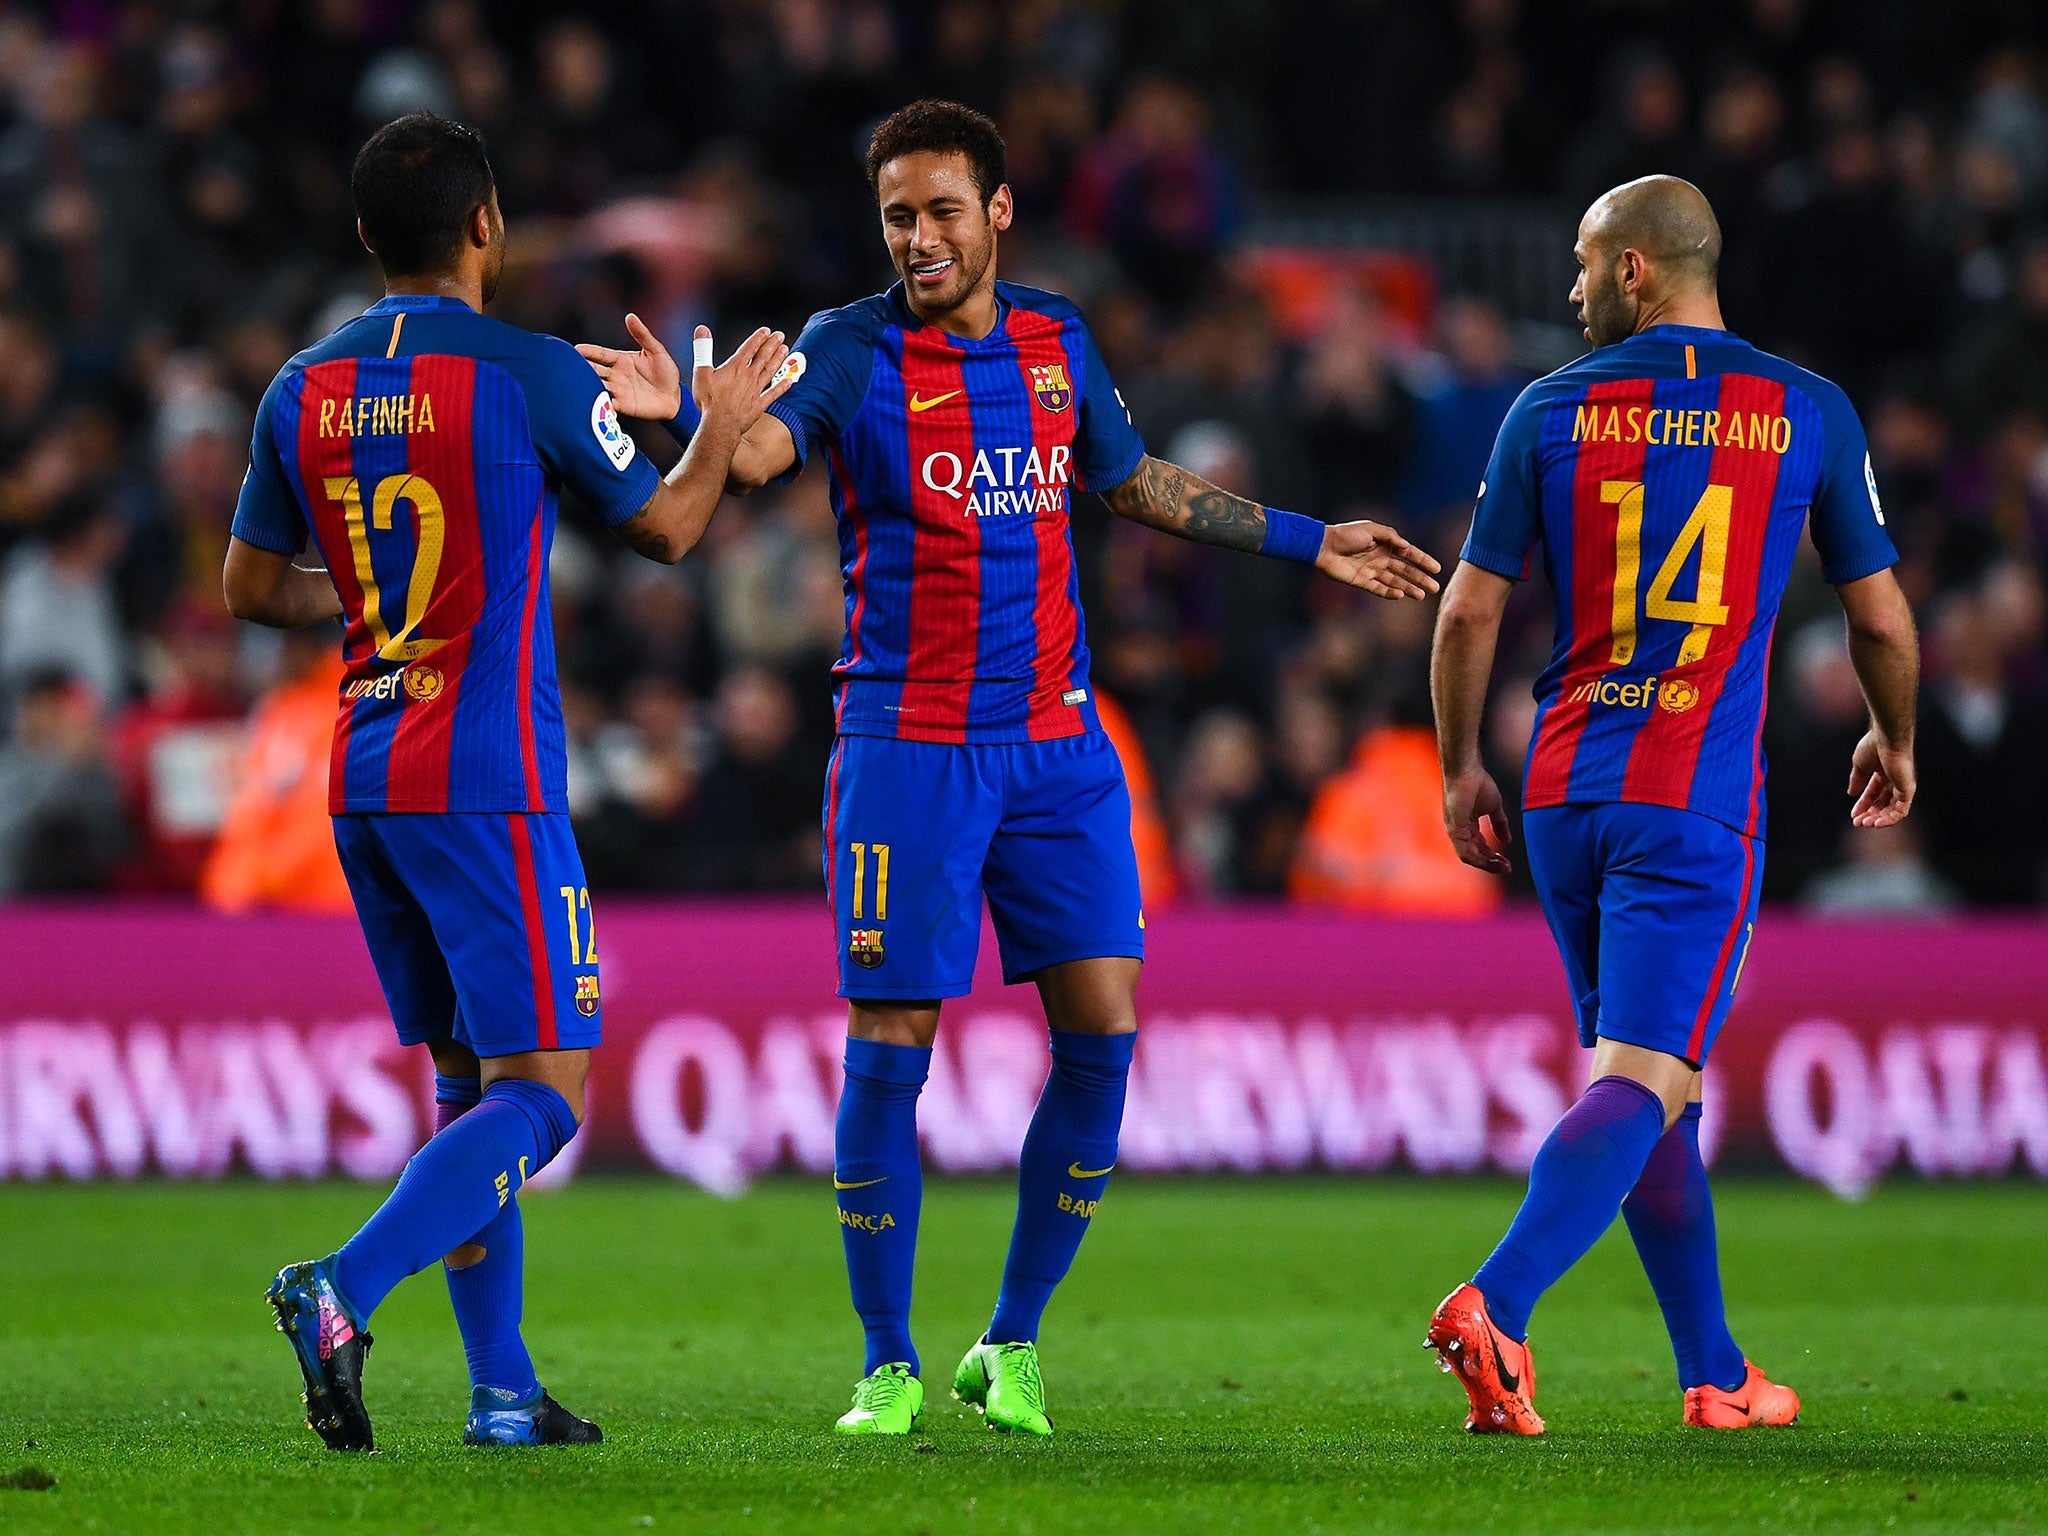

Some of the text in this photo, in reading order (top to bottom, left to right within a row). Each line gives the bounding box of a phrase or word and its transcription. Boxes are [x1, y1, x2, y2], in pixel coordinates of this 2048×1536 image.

[319, 394, 435, 438] RAFINHA
[1571, 405, 1792, 455] MASCHERANO
[921, 445, 1070, 500] QATAR
[323, 473, 450, 662] 12
[1600, 480, 1734, 667] 14
[850, 842, 890, 921] 11
[559, 886, 599, 966] 12
[0, 1014, 416, 1180] RWAYS
[629, 1014, 1052, 1200] QAR
[836, 1205, 896, 1236] ARÇA
